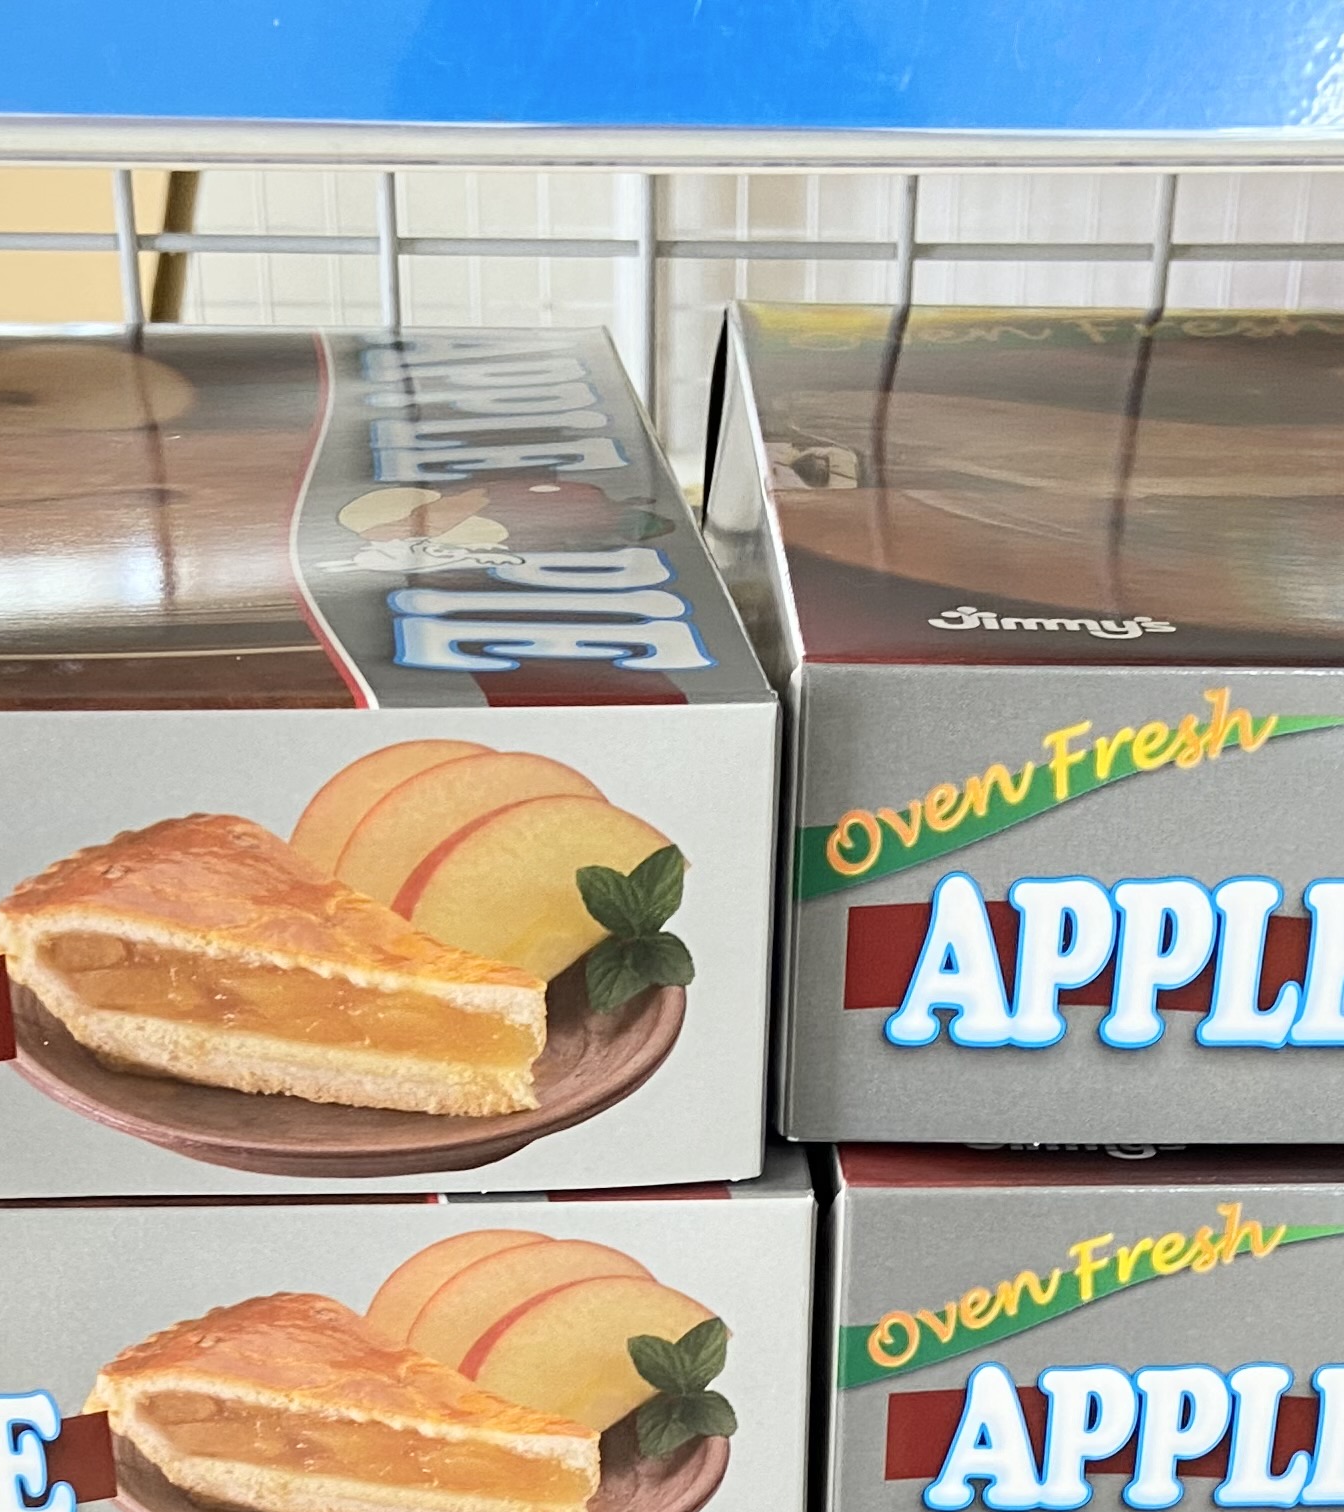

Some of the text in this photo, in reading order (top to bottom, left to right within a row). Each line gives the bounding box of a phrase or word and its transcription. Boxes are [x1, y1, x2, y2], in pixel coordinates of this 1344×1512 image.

[790, 326, 1052, 352] Oen
[388, 547, 718, 672] PIE
[927, 604, 1176, 640] Jimmy's
[826, 688, 1280, 876] Oven Fresh
[867, 1202, 1288, 1368] Oven Fresh
